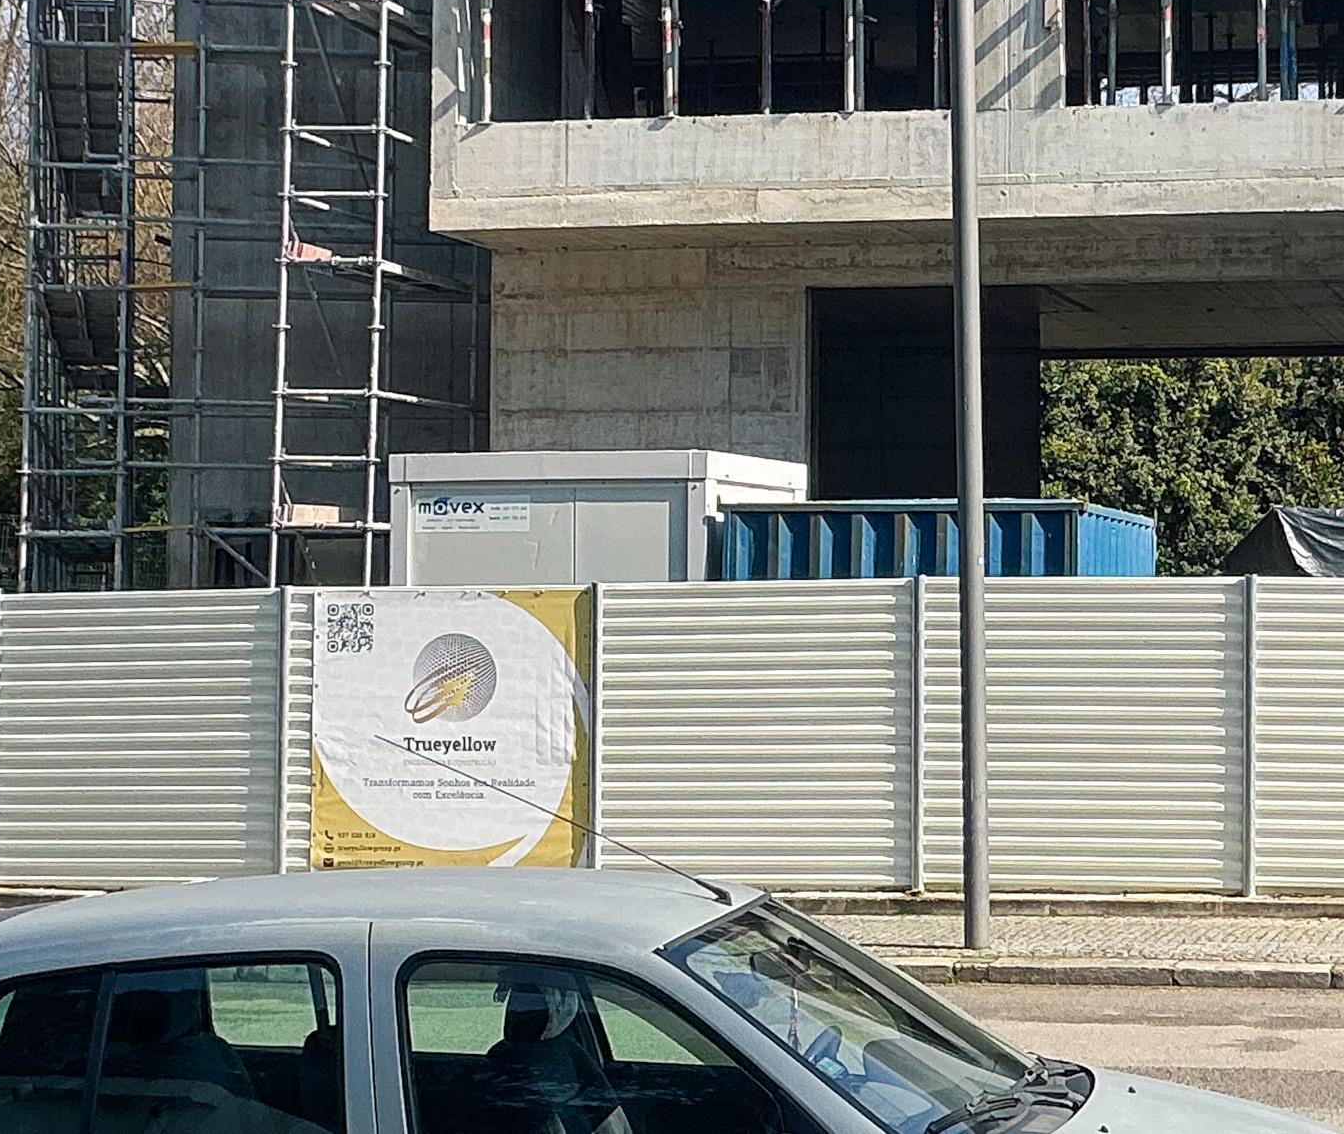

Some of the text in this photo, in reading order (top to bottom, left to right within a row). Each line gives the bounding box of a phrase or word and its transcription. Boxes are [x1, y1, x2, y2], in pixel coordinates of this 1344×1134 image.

[418, 500, 485, 515] movex
[403, 736, 497, 754] Trueyellow
[437, 777, 471, 787] Sonhos
